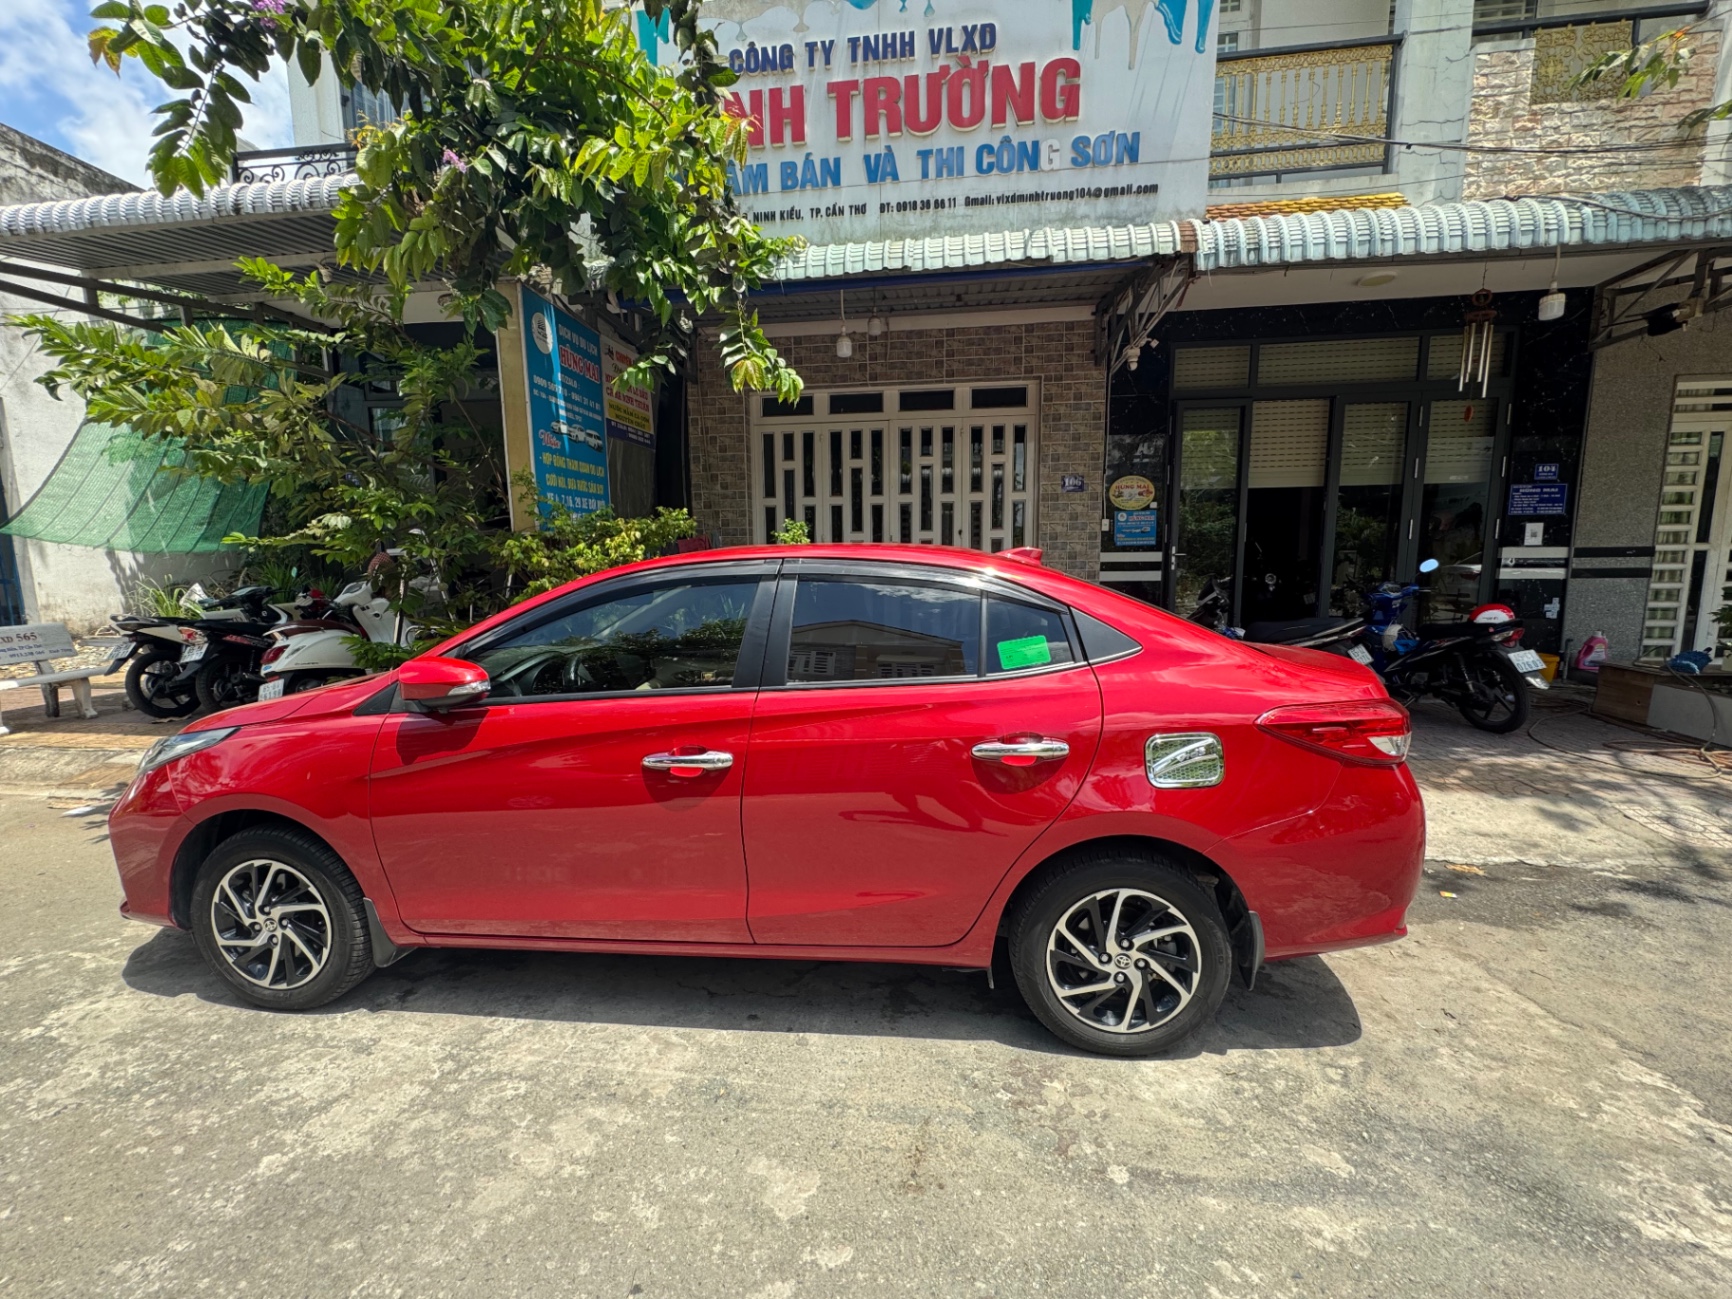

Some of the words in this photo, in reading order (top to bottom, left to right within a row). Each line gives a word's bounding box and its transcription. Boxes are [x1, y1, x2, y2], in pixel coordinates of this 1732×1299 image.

[729, 41, 795, 75] CÔNG
[805, 39, 835, 70] TY
[847, 30, 915, 65] TNHH
[928, 22, 997, 58] VLXD
[826, 55, 1081, 140] TRƯỜNG
[726, 160, 768, 197] ÂM
[780, 152, 841, 192] BÁN
[863, 145, 900, 185] VÀ
[917, 145, 964, 180] THI
[975, 135, 1060, 176] CÔNG
[1070, 130, 1141, 168] SƠN
[753, 210, 776, 223] NINH
[809, 207, 823, 218] TP.
[848, 203, 867, 215] THƠ
[880, 202, 894, 213] ĐT:
[896, 200, 917, 212] 0918
[947, 197, 957, 208] 11
[584, 358, 601, 384] MAI
[1064, 476, 1082, 487] 106
[16, 632, 38, 642] 565
